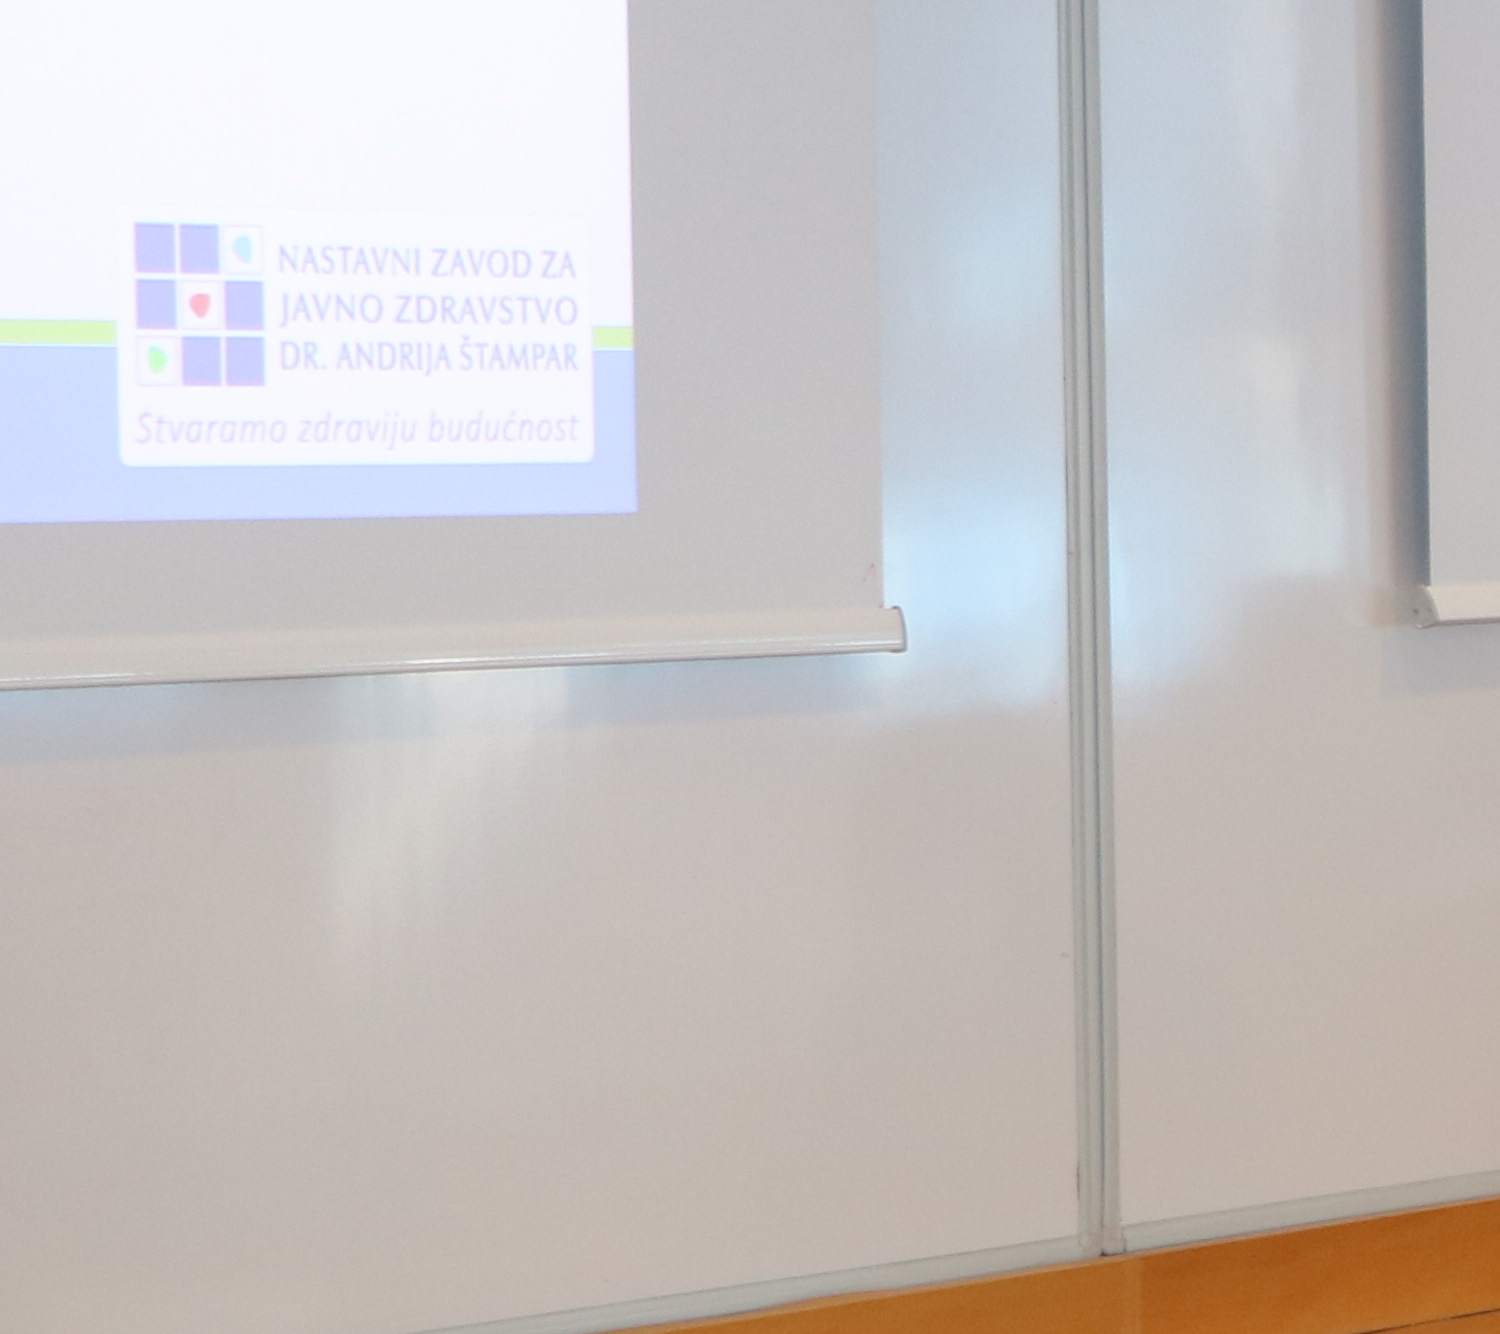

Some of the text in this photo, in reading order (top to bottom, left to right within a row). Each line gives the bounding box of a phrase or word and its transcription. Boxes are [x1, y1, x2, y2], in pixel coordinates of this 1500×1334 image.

[277, 243, 578, 280] NASTAVNI ZAVOD ZA
[279, 291, 580, 328] JAVNO ZDRAVSTVO
[279, 333, 581, 377] DR. ANDRIJA ŠTAMPAR
[135, 408, 581, 452] Stvaramo zdraviju budućnost
